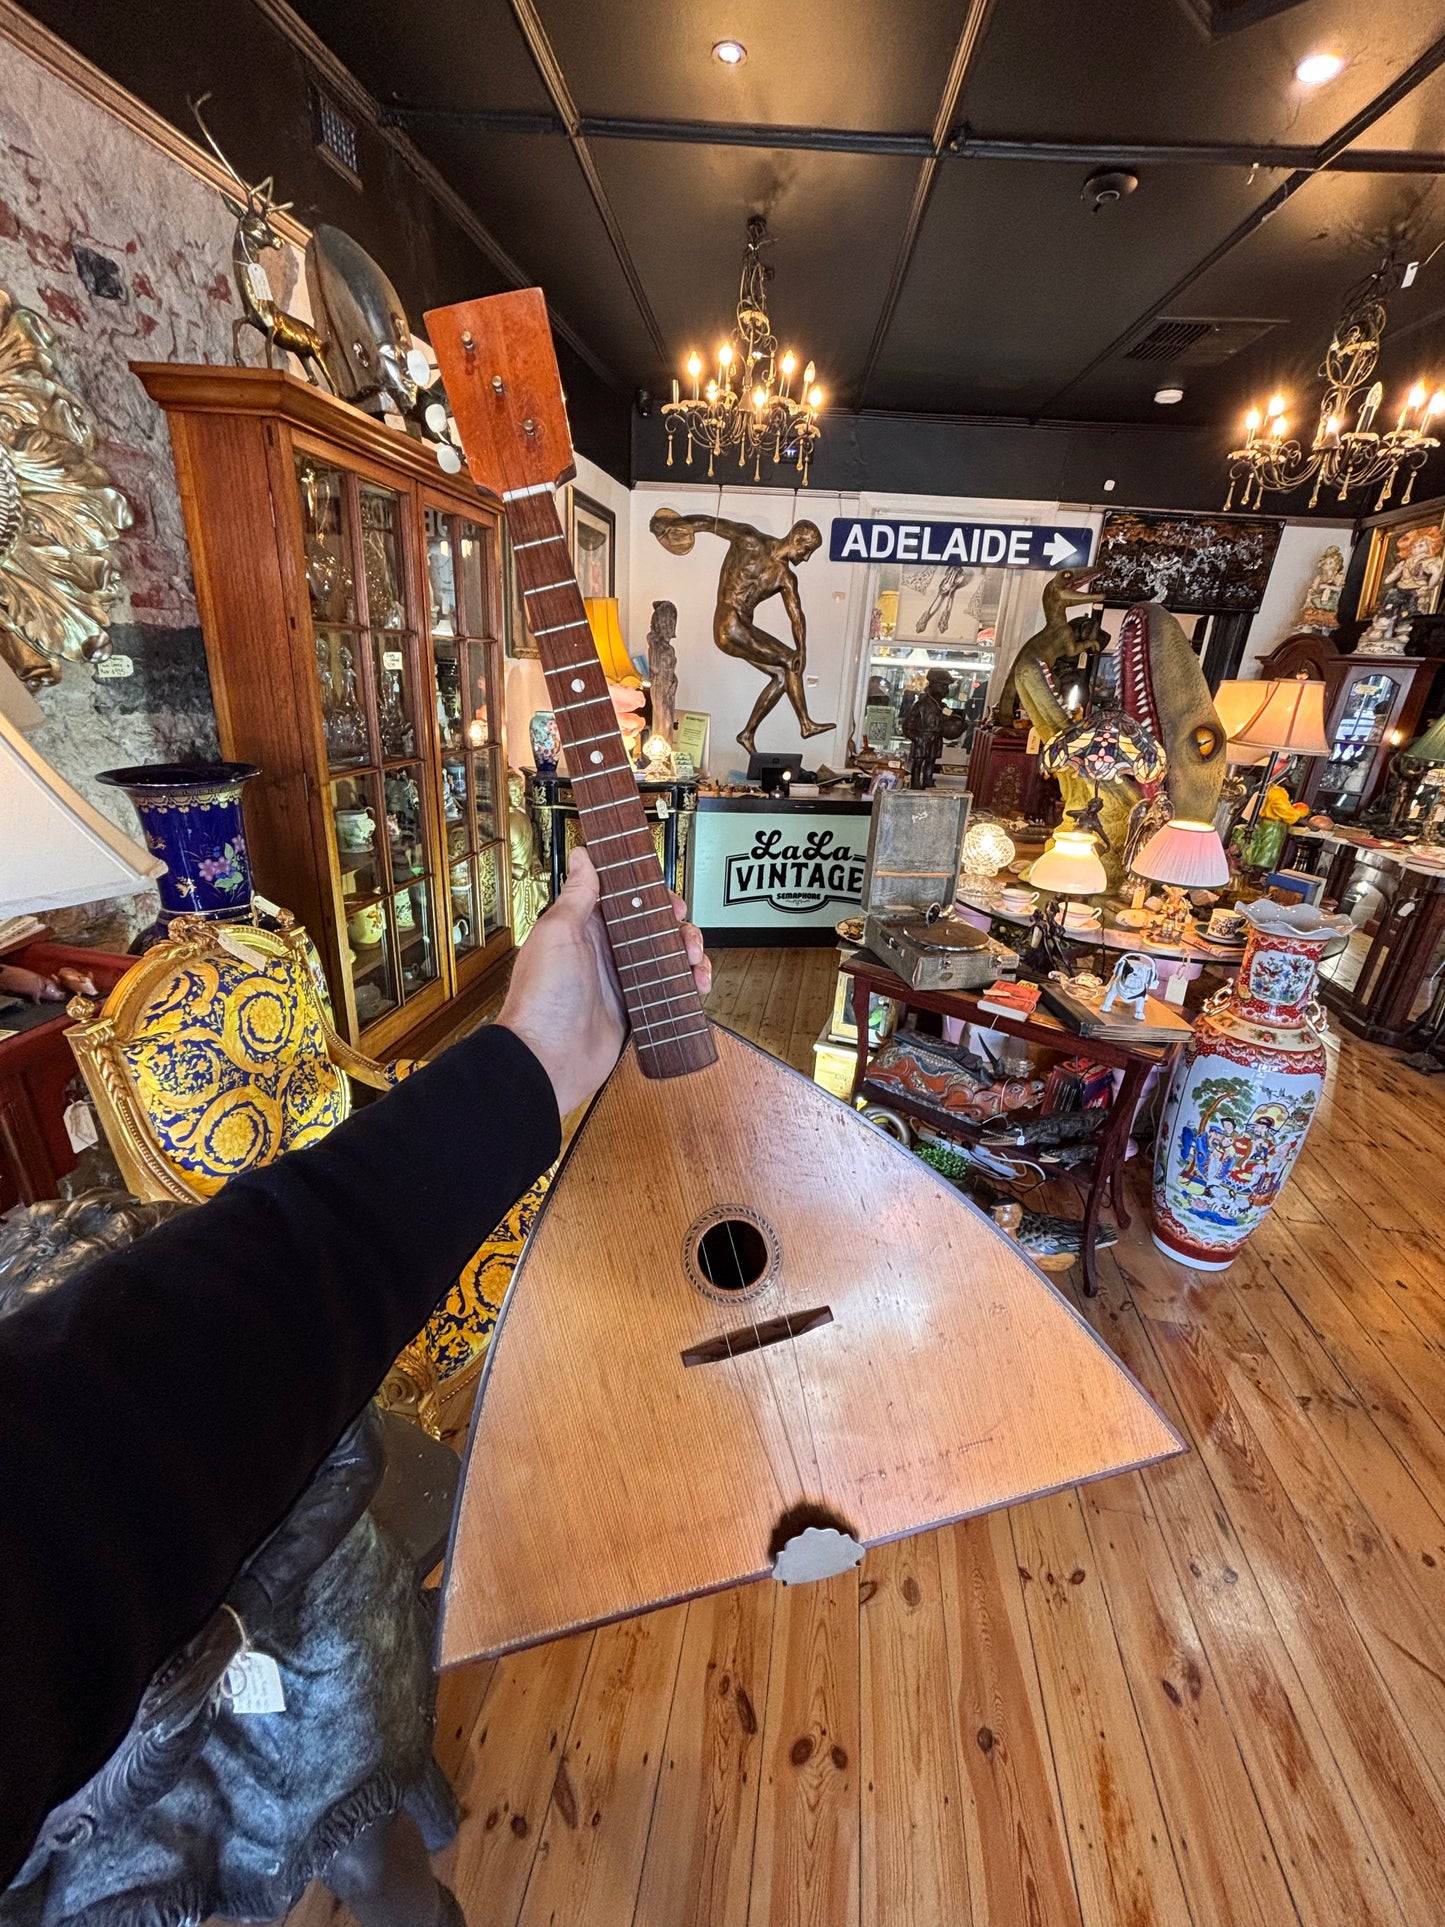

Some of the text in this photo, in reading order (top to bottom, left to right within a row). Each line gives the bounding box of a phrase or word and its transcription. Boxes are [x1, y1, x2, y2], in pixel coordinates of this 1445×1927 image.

[841, 523, 1033, 565] ADELAIDE
[736, 862, 864, 893] VINTAGE
[777, 892, 821, 900] SEMAPHORE
